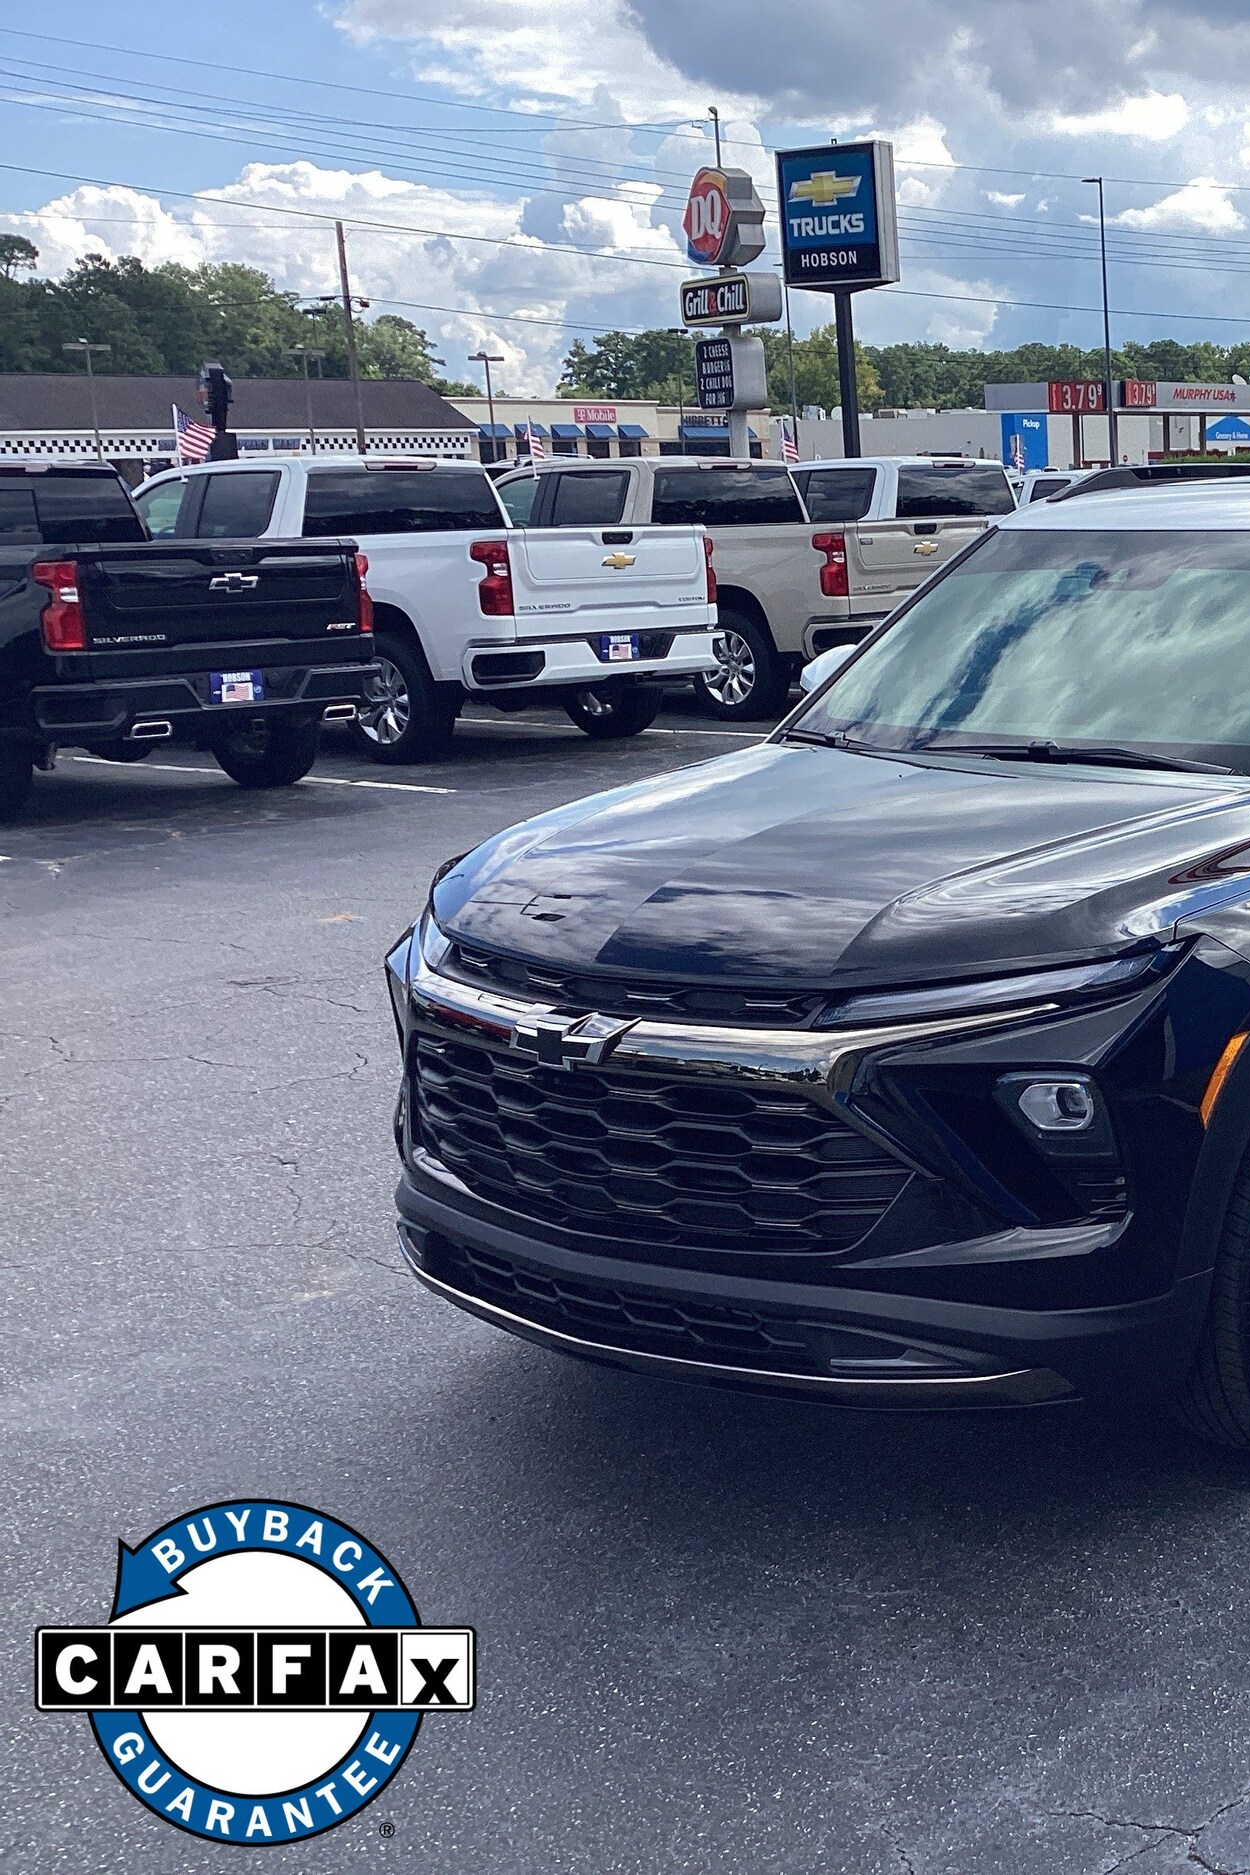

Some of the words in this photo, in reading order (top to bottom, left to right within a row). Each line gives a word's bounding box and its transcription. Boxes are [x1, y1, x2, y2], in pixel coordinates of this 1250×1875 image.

[691, 189, 722, 241] DQ
[789, 212, 865, 238] TRUCKS
[801, 250, 857, 268] HOBSON
[685, 288, 709, 317] Grill
[717, 283, 744, 313] Chill
[708, 343, 729, 358] CHEESE
[700, 378, 705, 390] 2
[705, 392, 716, 405] FOR
[1173, 388, 1212, 400] MURPHY
[1212, 389, 1231, 401] USA
[1022, 418, 1041, 430] Pickup
[518, 603, 571, 611] SILVERADO
[326, 622, 356, 630] RST
[93, 634, 166, 645] SILVERADO
[222, 673, 251, 683] HOBSON
